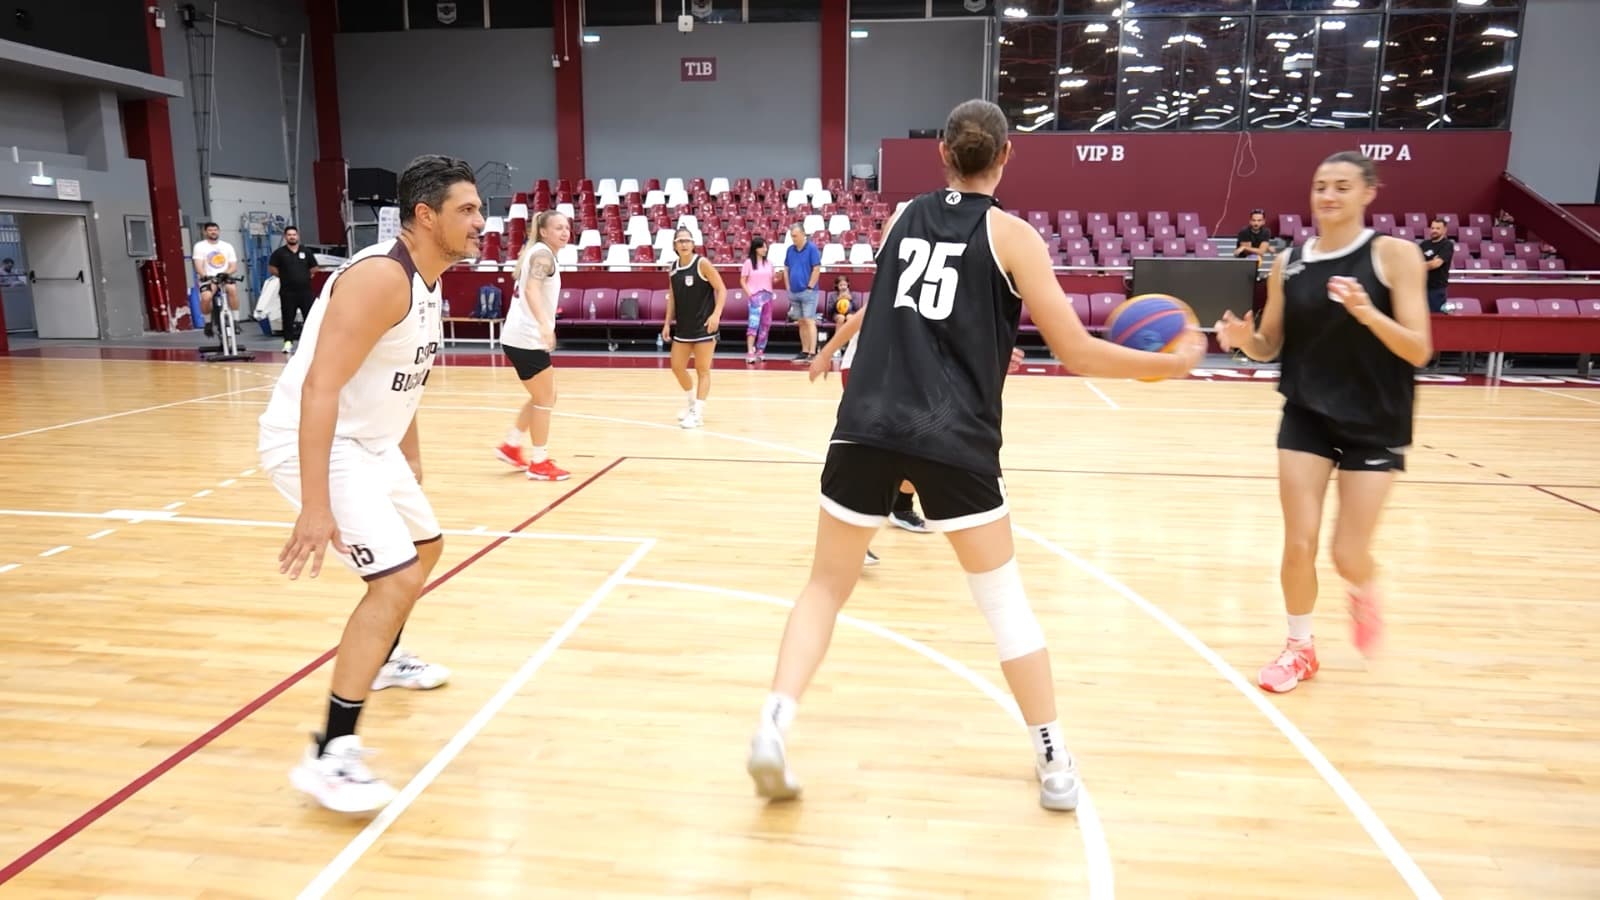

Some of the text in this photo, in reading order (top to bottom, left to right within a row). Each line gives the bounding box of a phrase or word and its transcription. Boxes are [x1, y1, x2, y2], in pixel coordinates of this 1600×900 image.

[685, 62, 713, 76] T1B
[1075, 144, 1125, 162] VIP B
[1359, 144, 1411, 161] VIP A
[894, 237, 968, 321] 25
